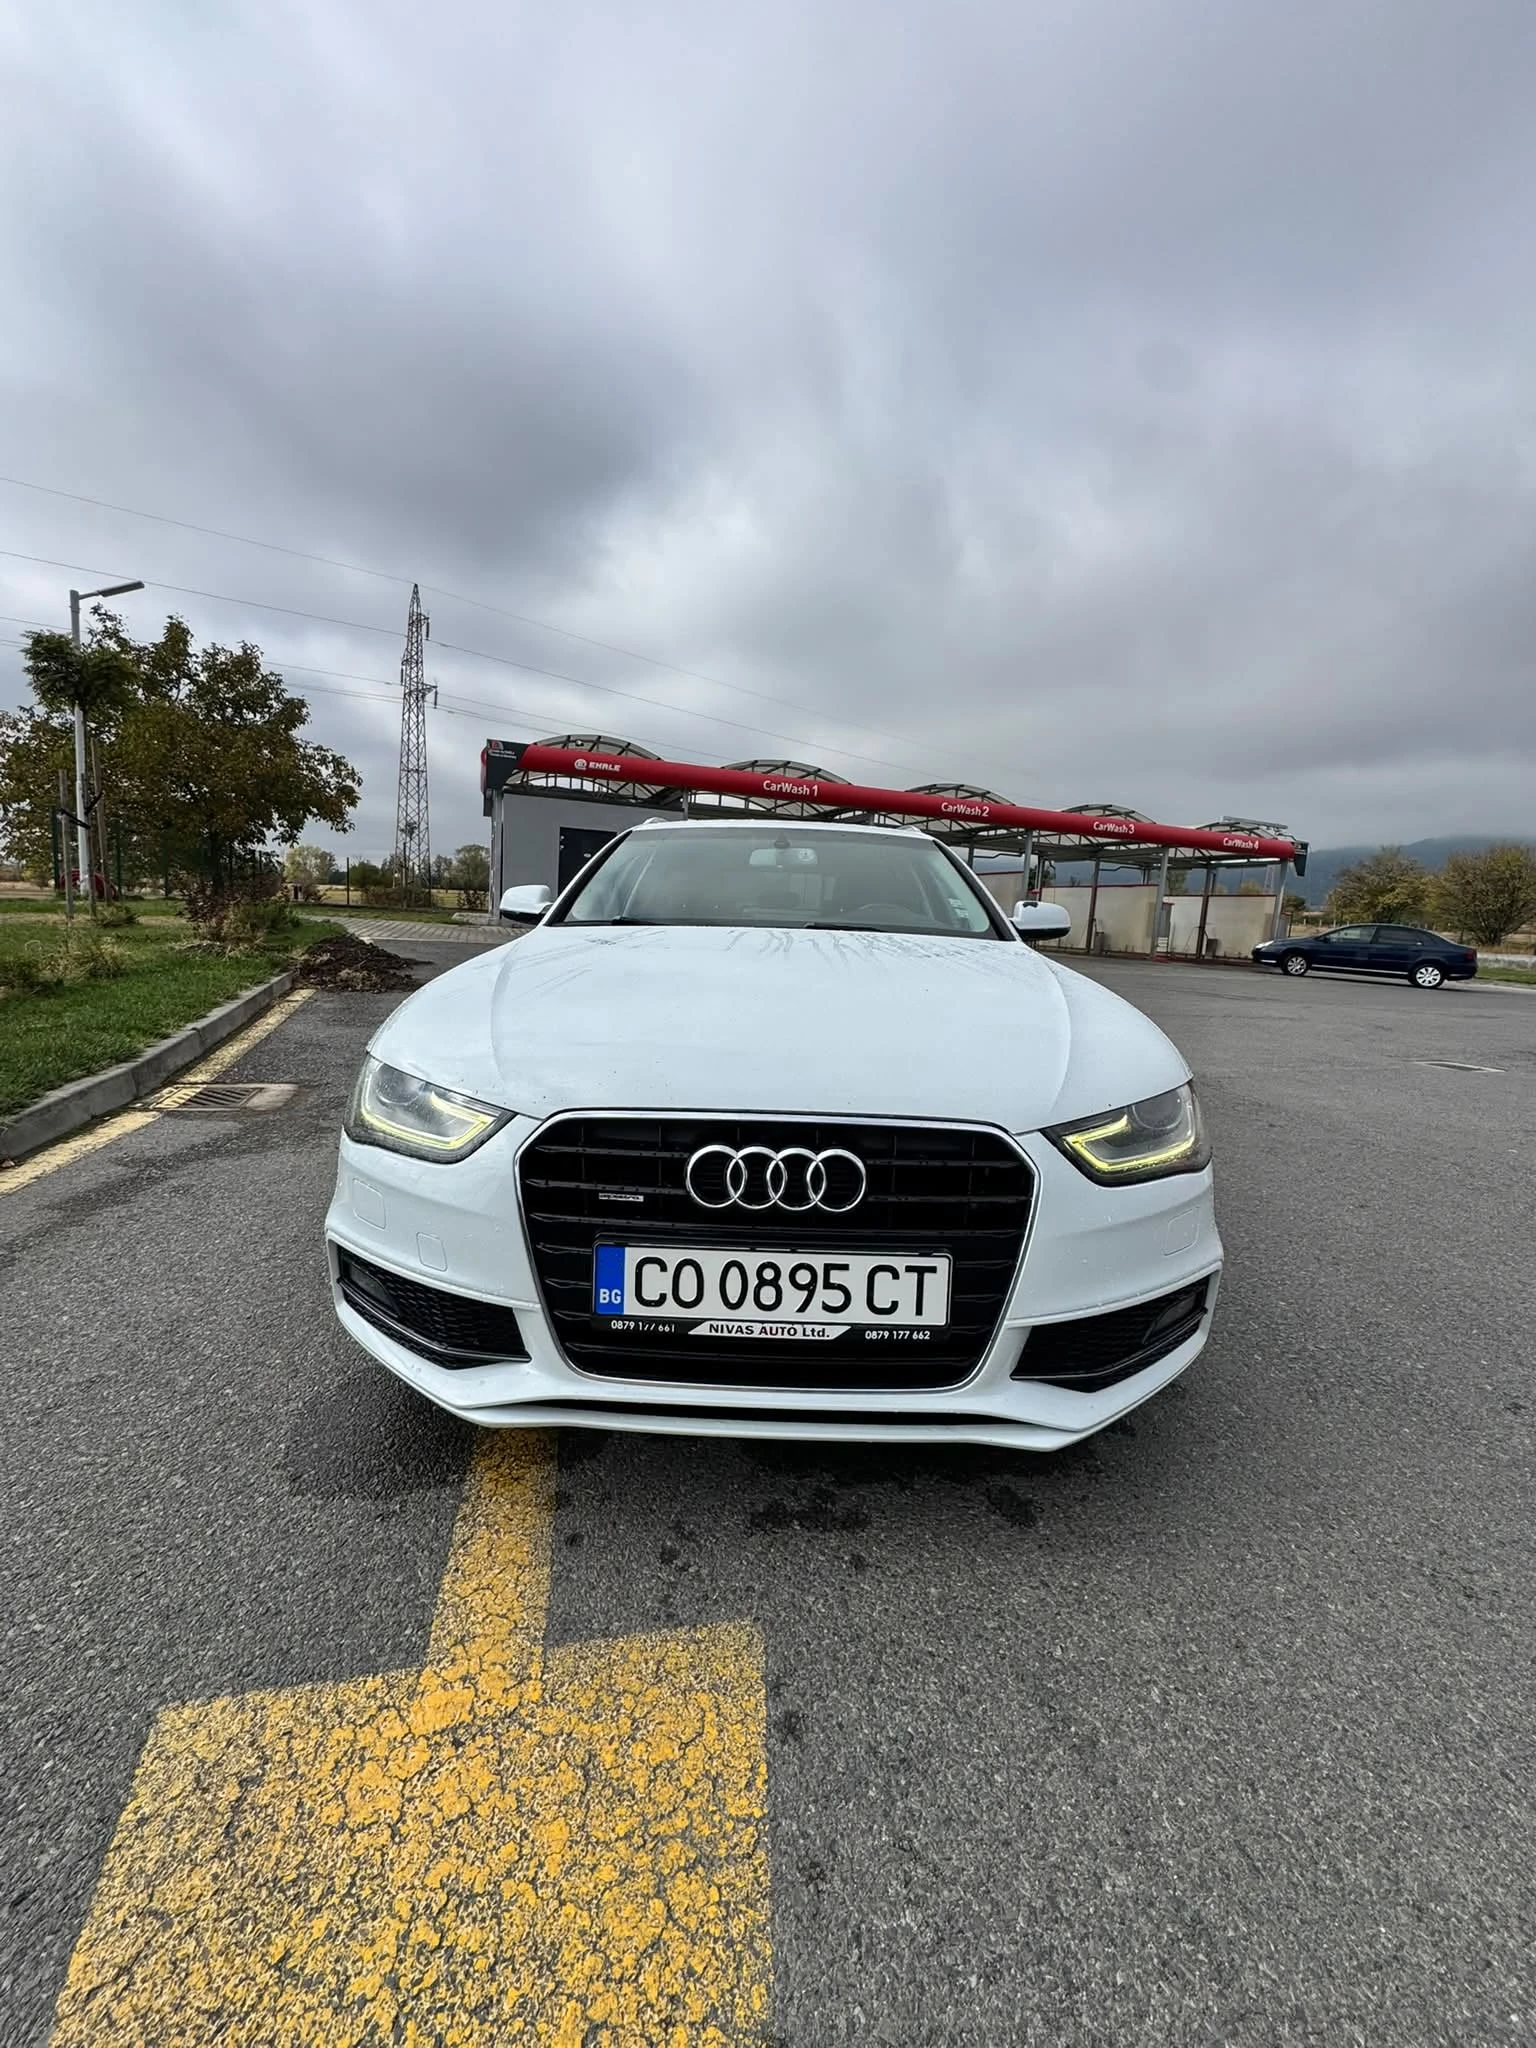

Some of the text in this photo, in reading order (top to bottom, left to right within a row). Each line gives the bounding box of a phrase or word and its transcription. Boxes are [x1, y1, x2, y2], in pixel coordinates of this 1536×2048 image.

[763, 780, 818, 797] CarWash 1
[941, 802, 990, 817] CarWash 2
[1093, 821, 1135, 834] CarWash 3
[1223, 837, 1259, 850] CarWash 4
[634, 1256, 938, 1317] CO 0895 CT
[599, 1288, 622, 1304] BG
[610, 1319, 635, 1331] 0879
[708, 1323, 830, 1338] NIVAS AUTO Ltd.
[865, 1330, 930, 1340] 0879 177 662
